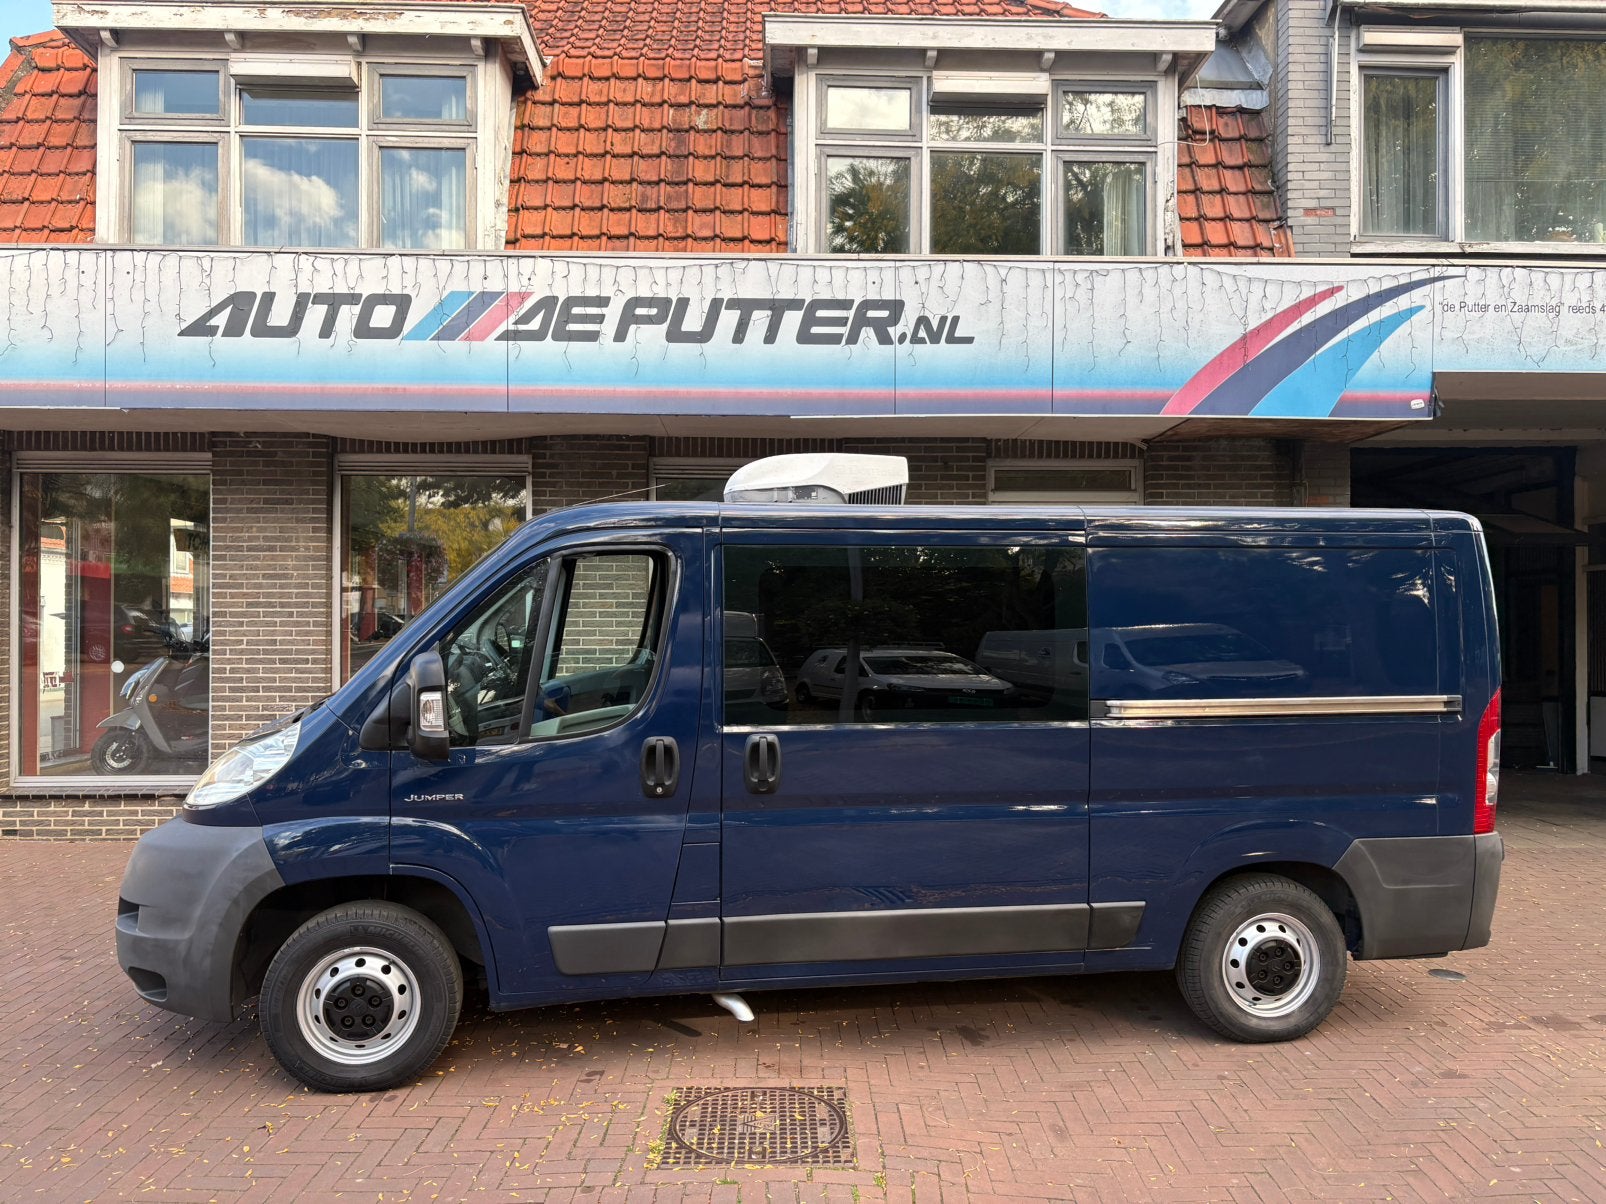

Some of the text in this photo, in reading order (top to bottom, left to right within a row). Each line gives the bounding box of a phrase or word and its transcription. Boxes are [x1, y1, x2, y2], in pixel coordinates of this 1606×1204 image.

[177, 291, 412, 339] AUTO
[1459, 301, 1490, 313] Putter
[1493, 303, 1507, 313] en
[1567, 303, 1597, 315] reeds
[1599, 303, 1606, 315] 4
[403, 793, 465, 802] JUMPER
